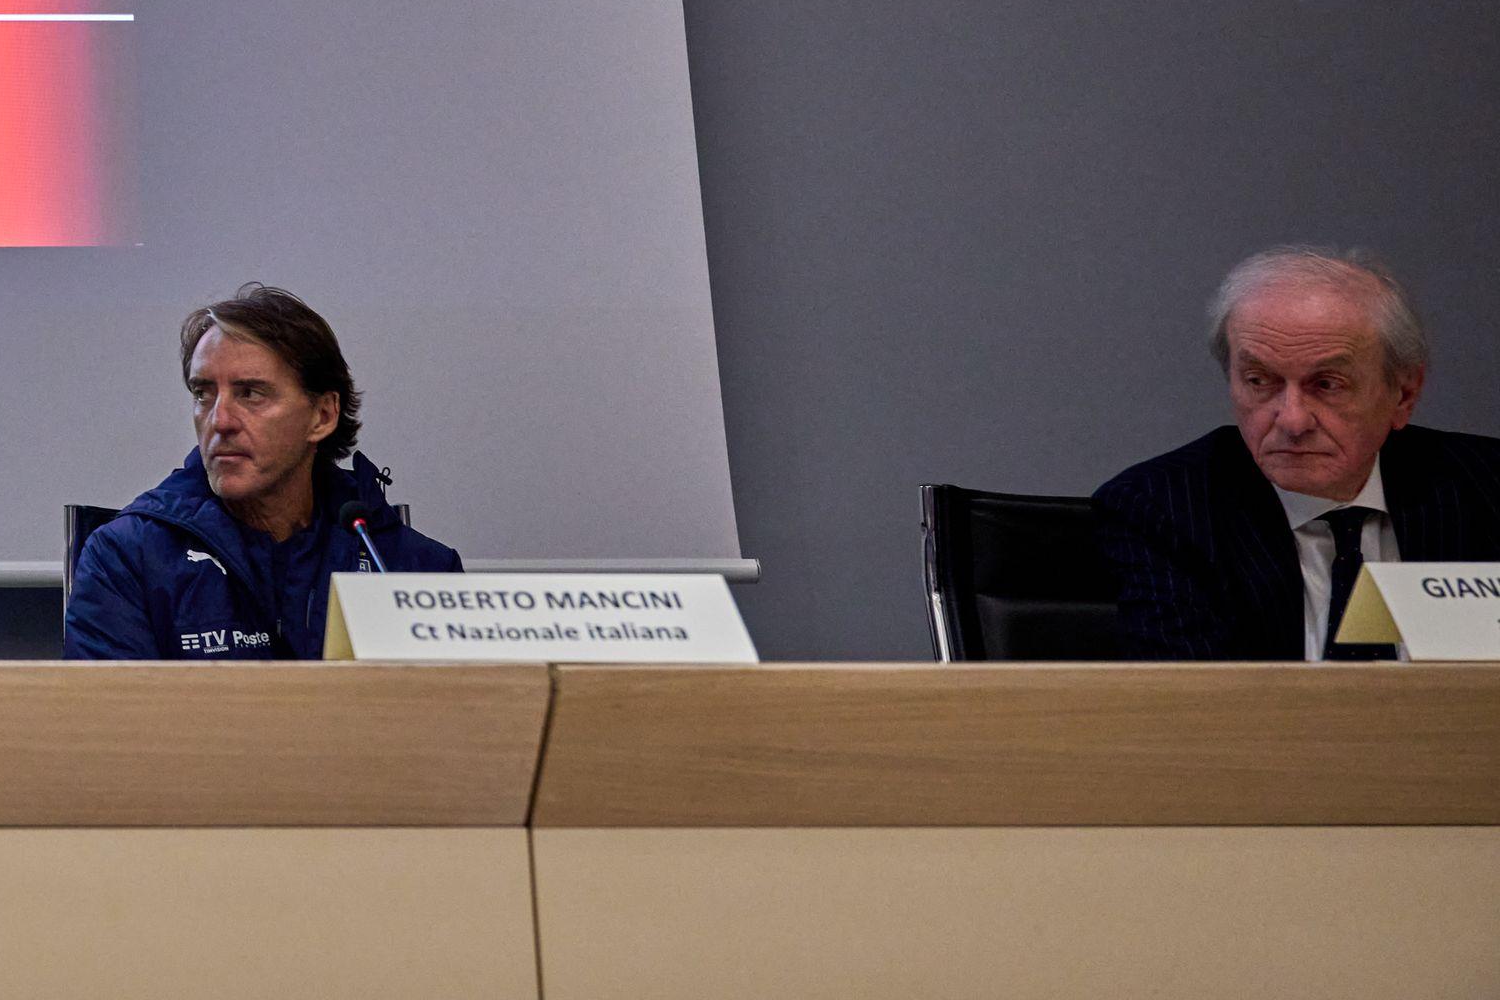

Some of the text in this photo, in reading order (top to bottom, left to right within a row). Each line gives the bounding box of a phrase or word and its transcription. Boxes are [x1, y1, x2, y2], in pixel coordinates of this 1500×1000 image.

[1422, 578, 1500, 598] GIAN
[392, 590, 684, 610] ROBERTO MANCINI
[201, 630, 269, 647] TV Poste
[411, 622, 688, 642] Ct Nazionale italiana
